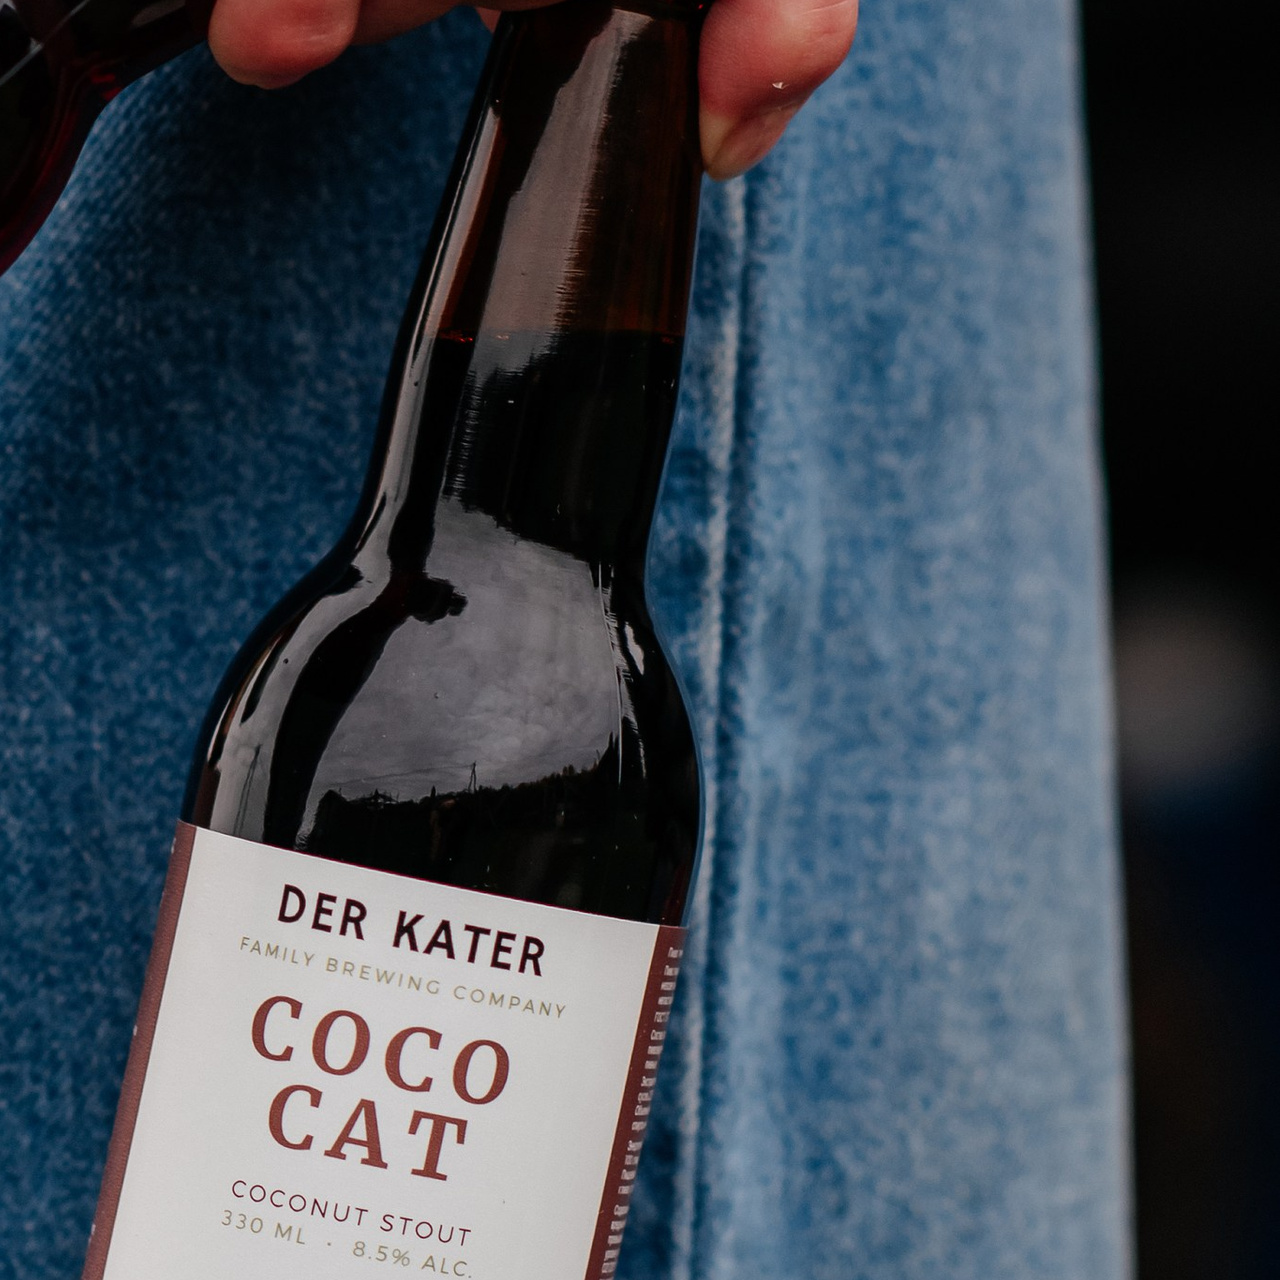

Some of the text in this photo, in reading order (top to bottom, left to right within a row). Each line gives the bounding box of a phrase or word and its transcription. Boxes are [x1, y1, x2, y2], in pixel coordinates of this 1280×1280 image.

[278, 884, 544, 976] DER KATER
[240, 937, 565, 1018] FAMILY BREWING COMPANY
[252, 996, 509, 1104] COCO
[269, 1085, 468, 1181] CAT
[222, 1210, 473, 1279] 330 ML 8.5% ALC.
[232, 1180, 471, 1246] COCONUT STOUT
